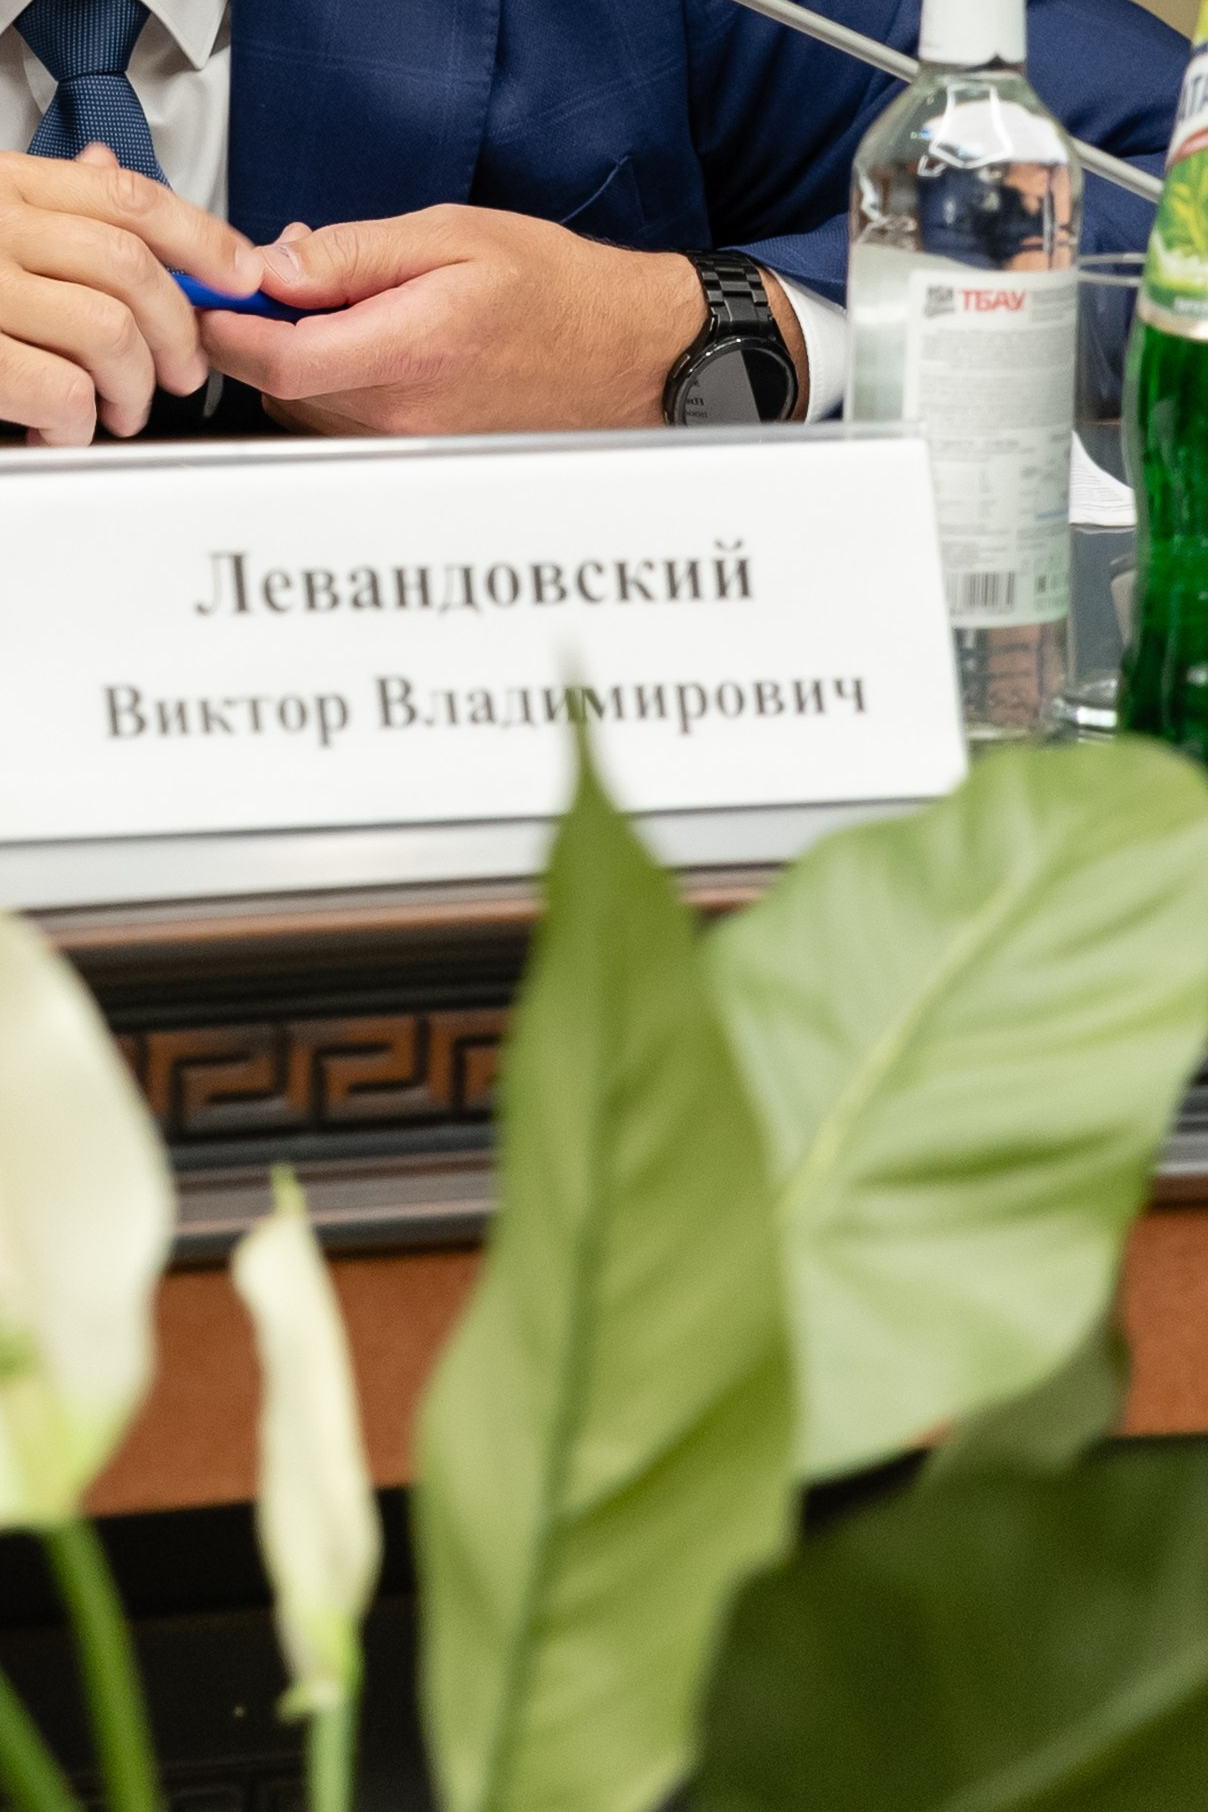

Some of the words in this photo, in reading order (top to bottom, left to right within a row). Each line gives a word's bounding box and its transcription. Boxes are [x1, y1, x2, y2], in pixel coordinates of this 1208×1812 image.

[195, 538, 755, 616] Левандовский
[103, 682, 352, 748] Виктор
[376, 675, 869, 736] Владимирович
